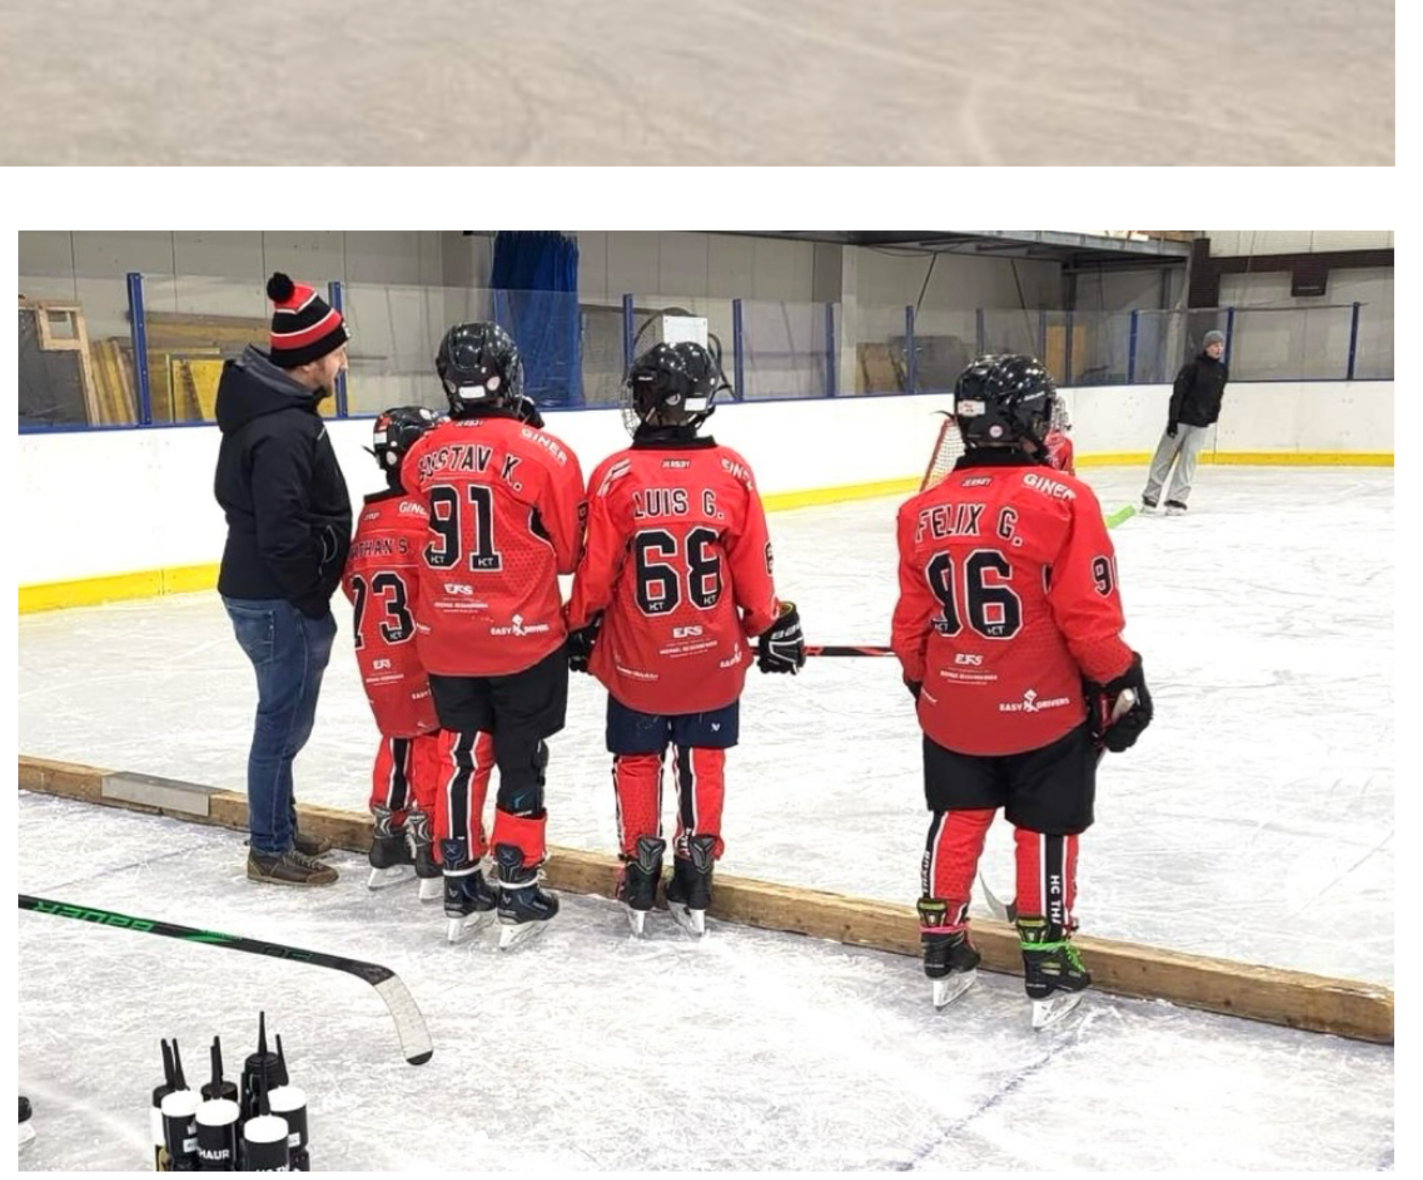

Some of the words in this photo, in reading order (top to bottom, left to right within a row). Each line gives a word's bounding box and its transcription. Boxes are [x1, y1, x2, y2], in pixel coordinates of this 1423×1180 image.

[521, 426, 568, 466] GINER
[502, 454, 523, 492] K.
[632, 488, 689, 518] LUIS
[701, 487, 725, 519] G.
[915, 503, 985, 543] FELIX
[996, 506, 1024, 547] G.
[423, 483, 503, 572] 91
[634, 525, 724, 617] 68
[1091, 554, 1120, 598] 9
